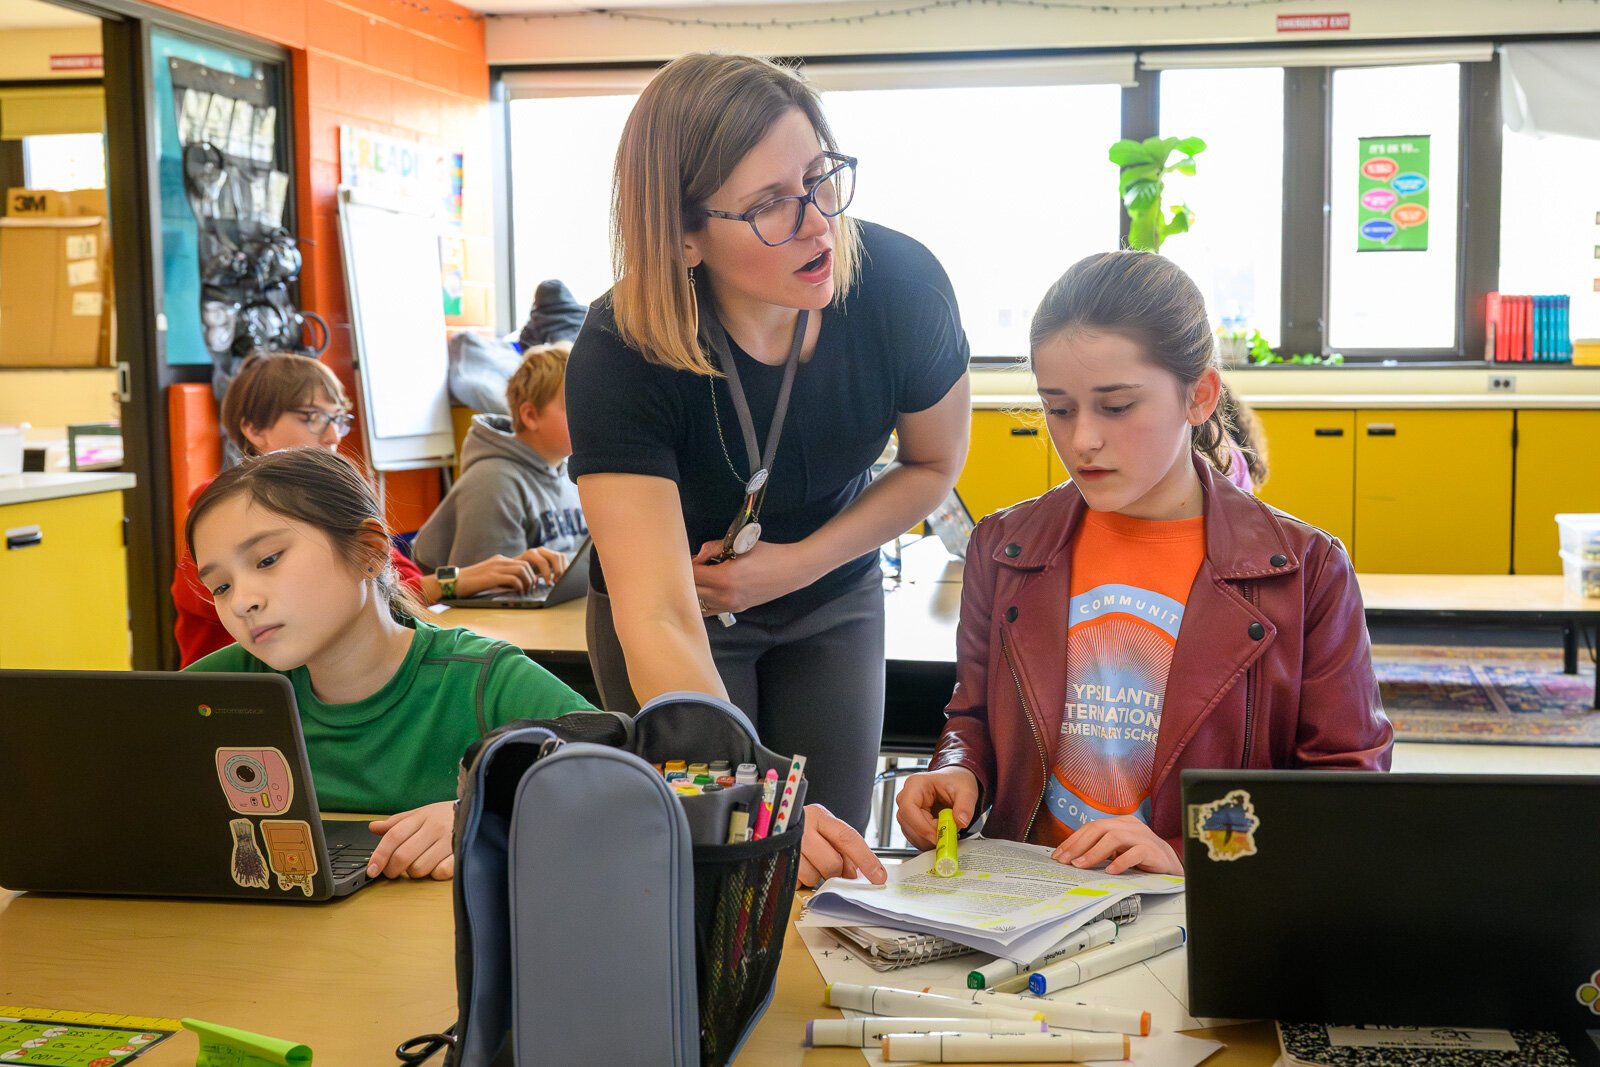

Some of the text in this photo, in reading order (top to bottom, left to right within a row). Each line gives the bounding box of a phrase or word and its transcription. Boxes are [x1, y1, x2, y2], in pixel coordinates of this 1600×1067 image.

[14, 194, 47, 212] 3M
[1079, 595, 1178, 624] COMMUNIT
[1072, 683, 1159, 710] YPSILANTI
[1064, 703, 1161, 730] TERNATION
[1057, 797, 1095, 825] CON
